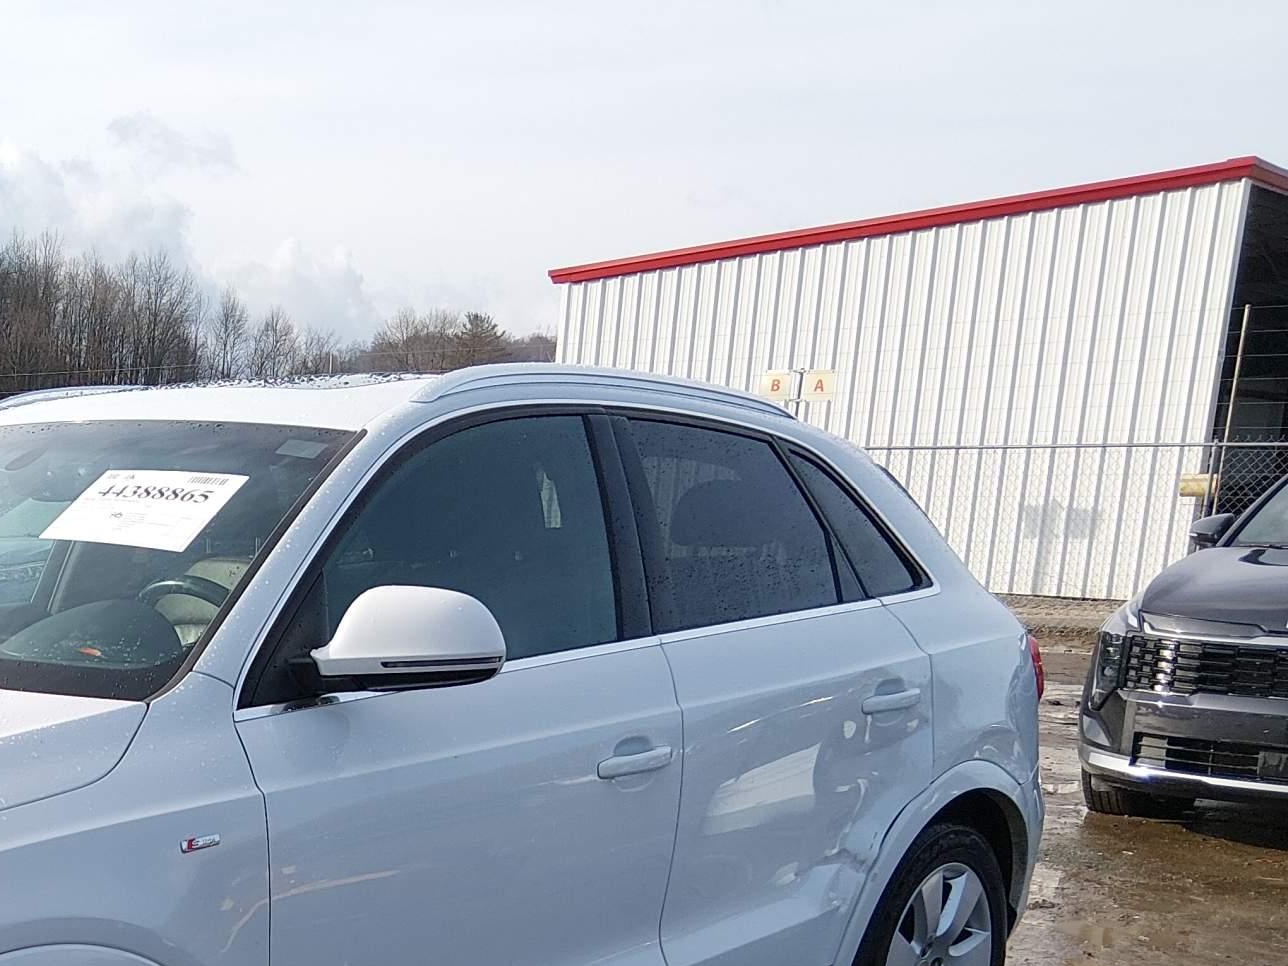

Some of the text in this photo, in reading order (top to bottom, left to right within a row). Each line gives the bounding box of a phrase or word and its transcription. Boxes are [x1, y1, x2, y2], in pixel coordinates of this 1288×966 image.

[770, 379, 781, 392] B
[814, 379, 824, 392] A
[98, 484, 215, 503] 44388865
